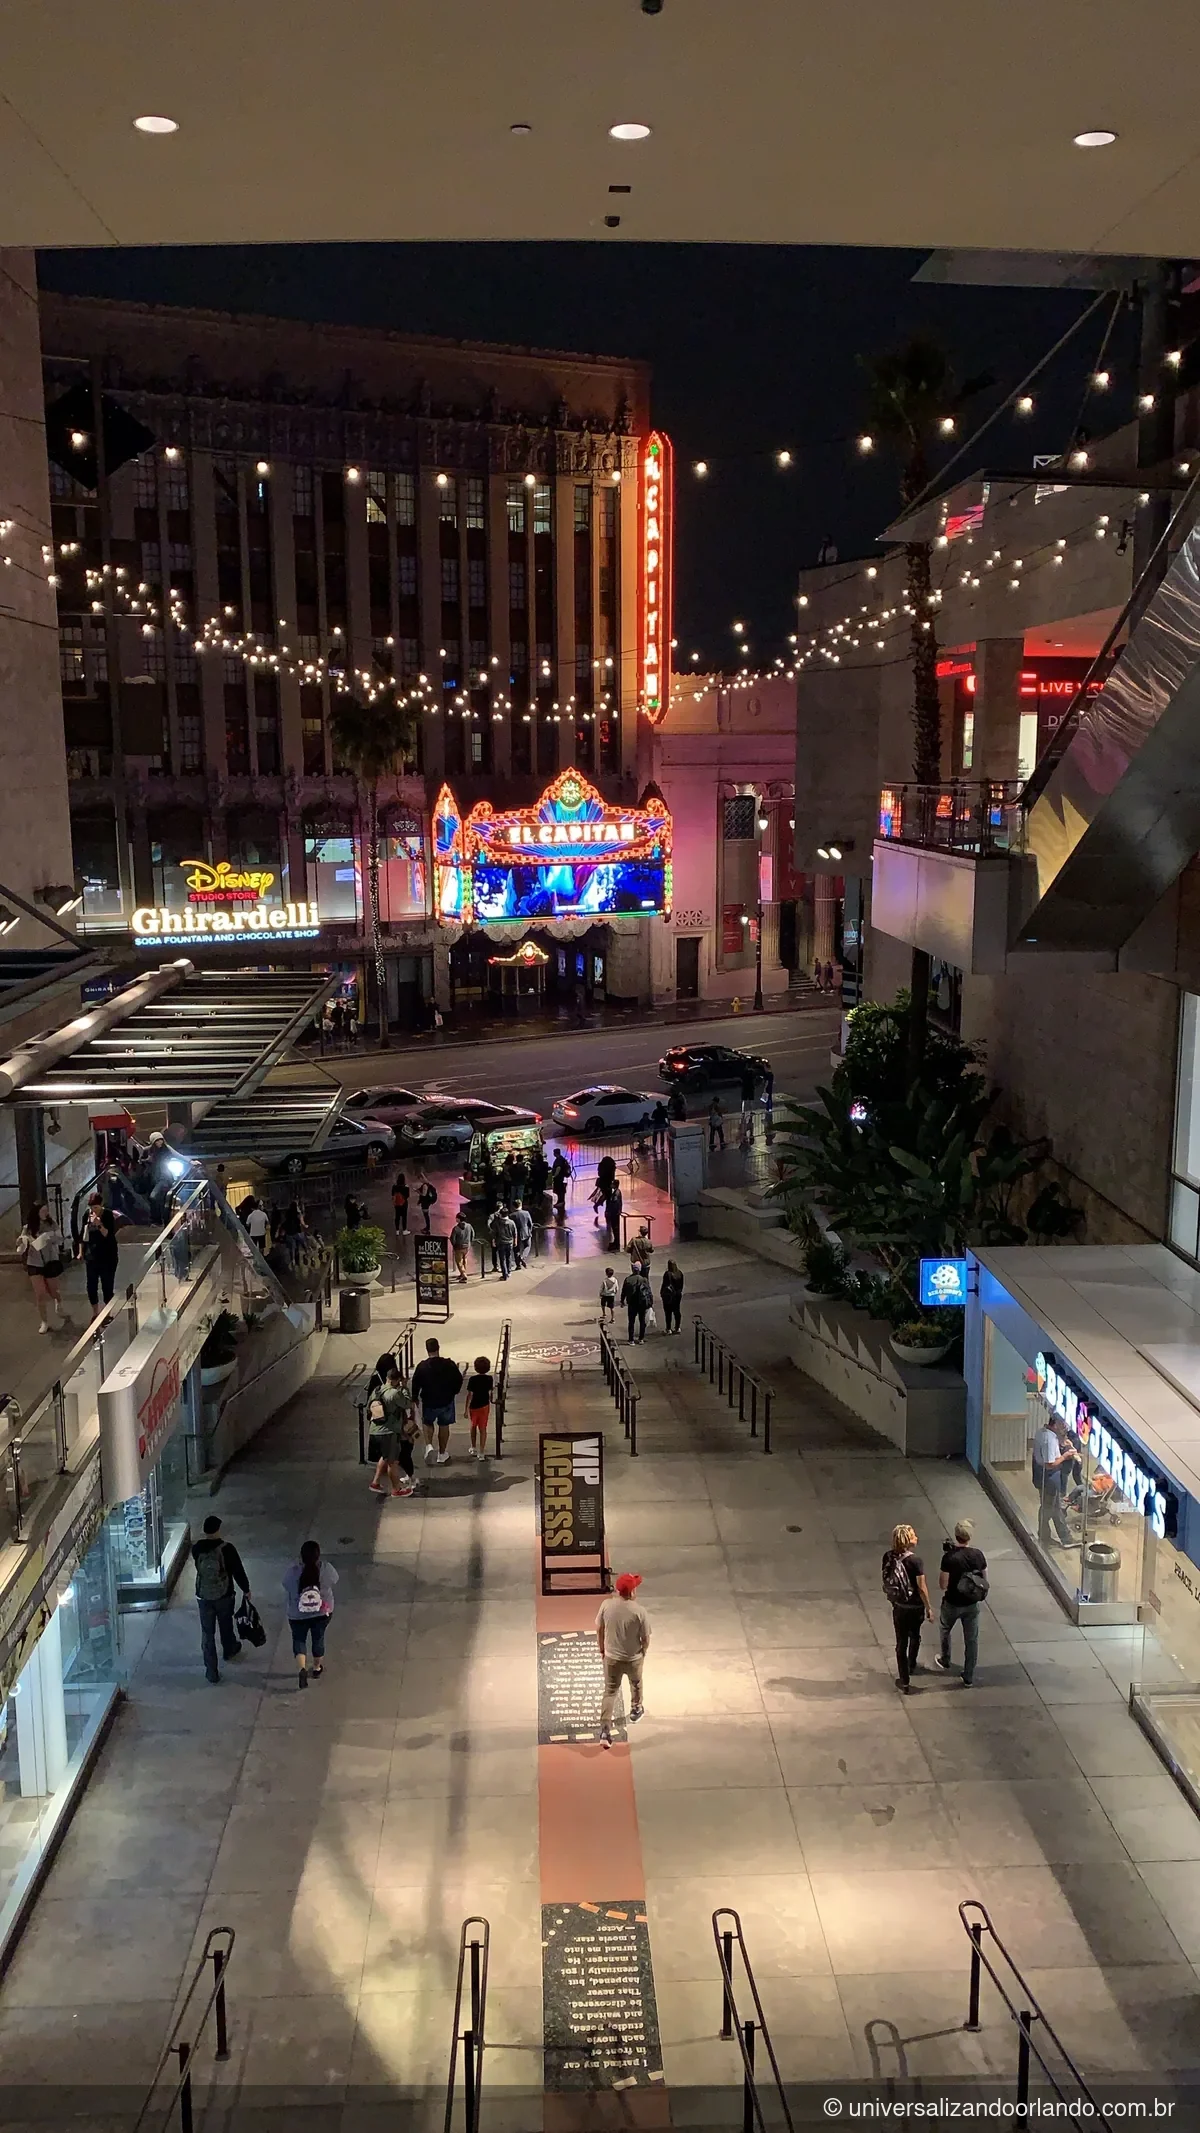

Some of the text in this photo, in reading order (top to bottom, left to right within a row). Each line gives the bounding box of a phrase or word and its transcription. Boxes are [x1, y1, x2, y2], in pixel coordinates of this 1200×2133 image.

[1040, 682, 1073, 693] LIVE
[508, 822, 635, 844] EL CAPITAN
[189, 891, 258, 902] STUDIO STORE
[131, 902, 321, 934] Ghirardelli
[134, 929, 320, 946] SODA FOUNTAIN AND CHOCOLATE SHOP
[424, 1241, 442, 1253] DECK
[1046, 1362, 1167, 1540] BEN & JERRY'S
[572, 1437, 600, 1486] VIP
[543, 1439, 574, 1548] ACCESS
[598, 1935, 628, 1943] movie
[563, 1946, 584, 1954] into
[605, 1945, 637, 1953] turned
[567, 1957, 581, 1965] He
[584, 1955, 629, 1963] manager.
[560, 1967, 577, 1975] got
[587, 1966, 639, 1975] eventually
[567, 1976, 640, 1986] happened, but
[617, 1988, 642, 1996] That
[568, 1999, 643, 2008] be discovered.
[586, 2011, 621, 2020] waited
[624, 2010, 643, 2019] and
[569, 2022, 644, 2033] studio, posed,
[586, 2034, 645, 2044] each movie
[590, 2046, 647, 2056] in front of
[563, 2061, 581, 2069] car
[583, 2060, 600, 2068] my
